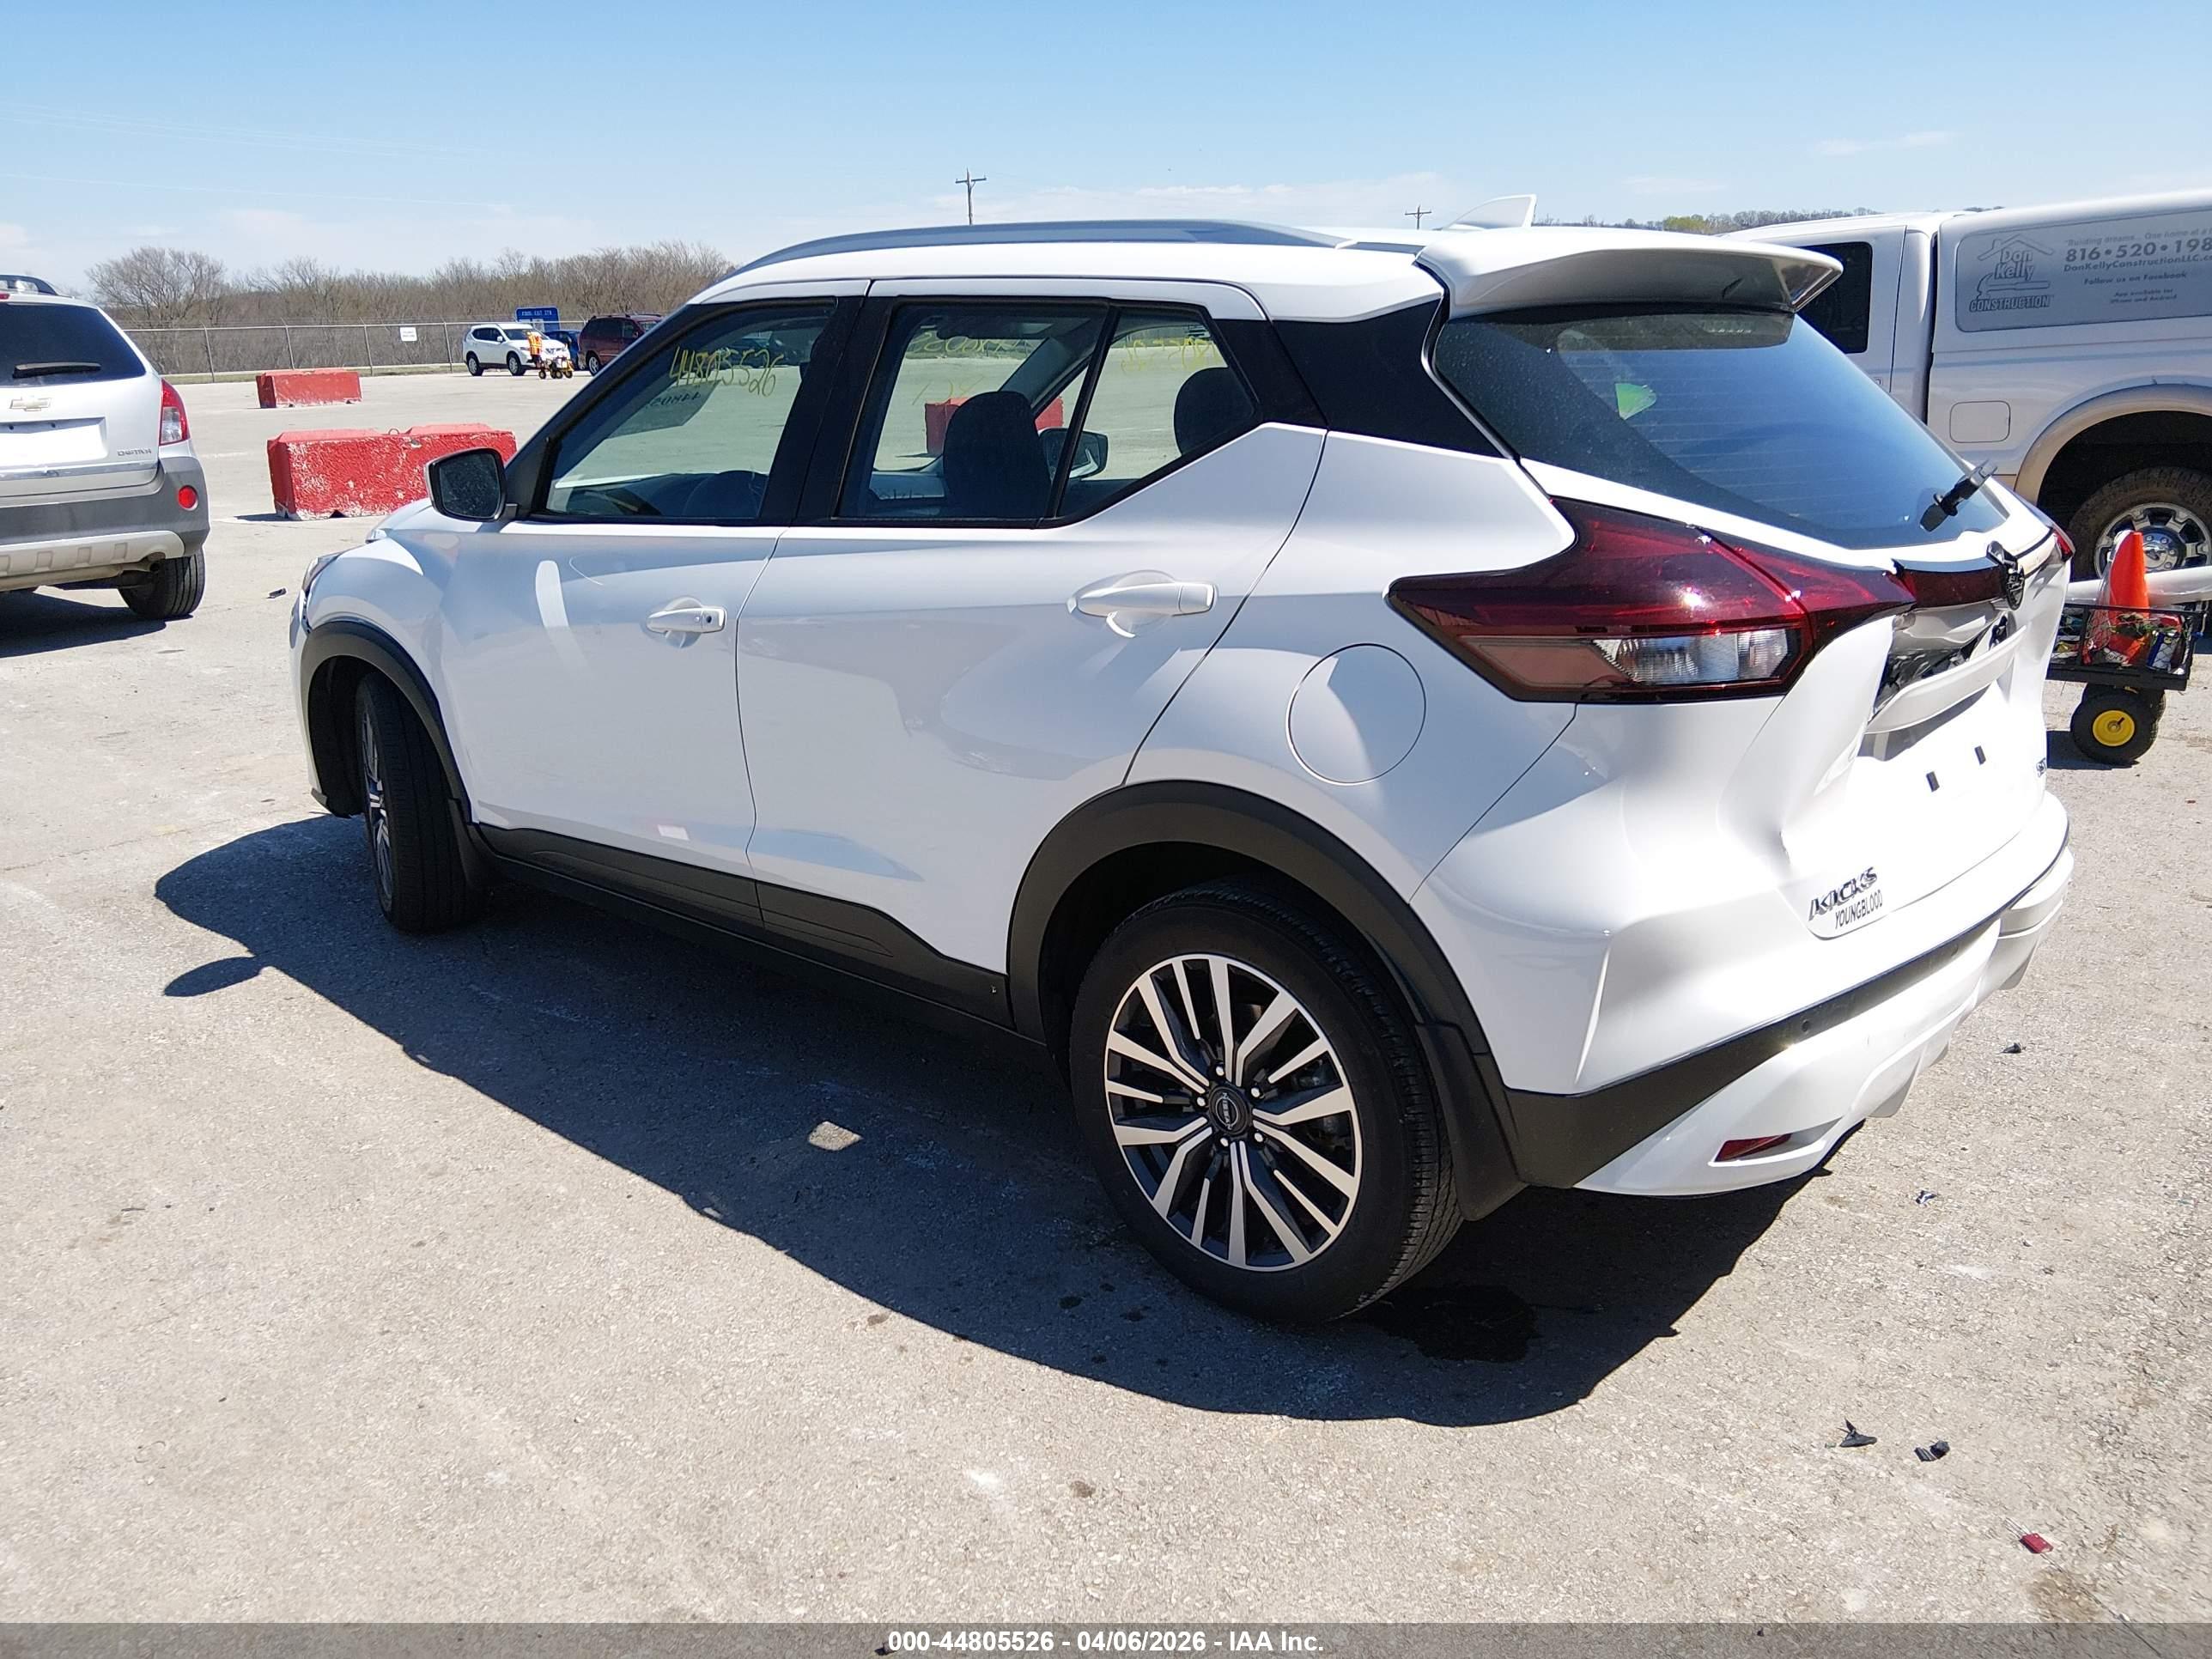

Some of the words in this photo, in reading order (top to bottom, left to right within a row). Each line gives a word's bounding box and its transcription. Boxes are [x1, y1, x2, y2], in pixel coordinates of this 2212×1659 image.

[2000, 248, 2033, 264] Don
[1994, 261, 2034, 282] Kelly
[1969, 295, 2051, 313] CONSTRUCTION
[1835, 889, 1883, 930] YOUNGBLOOD
